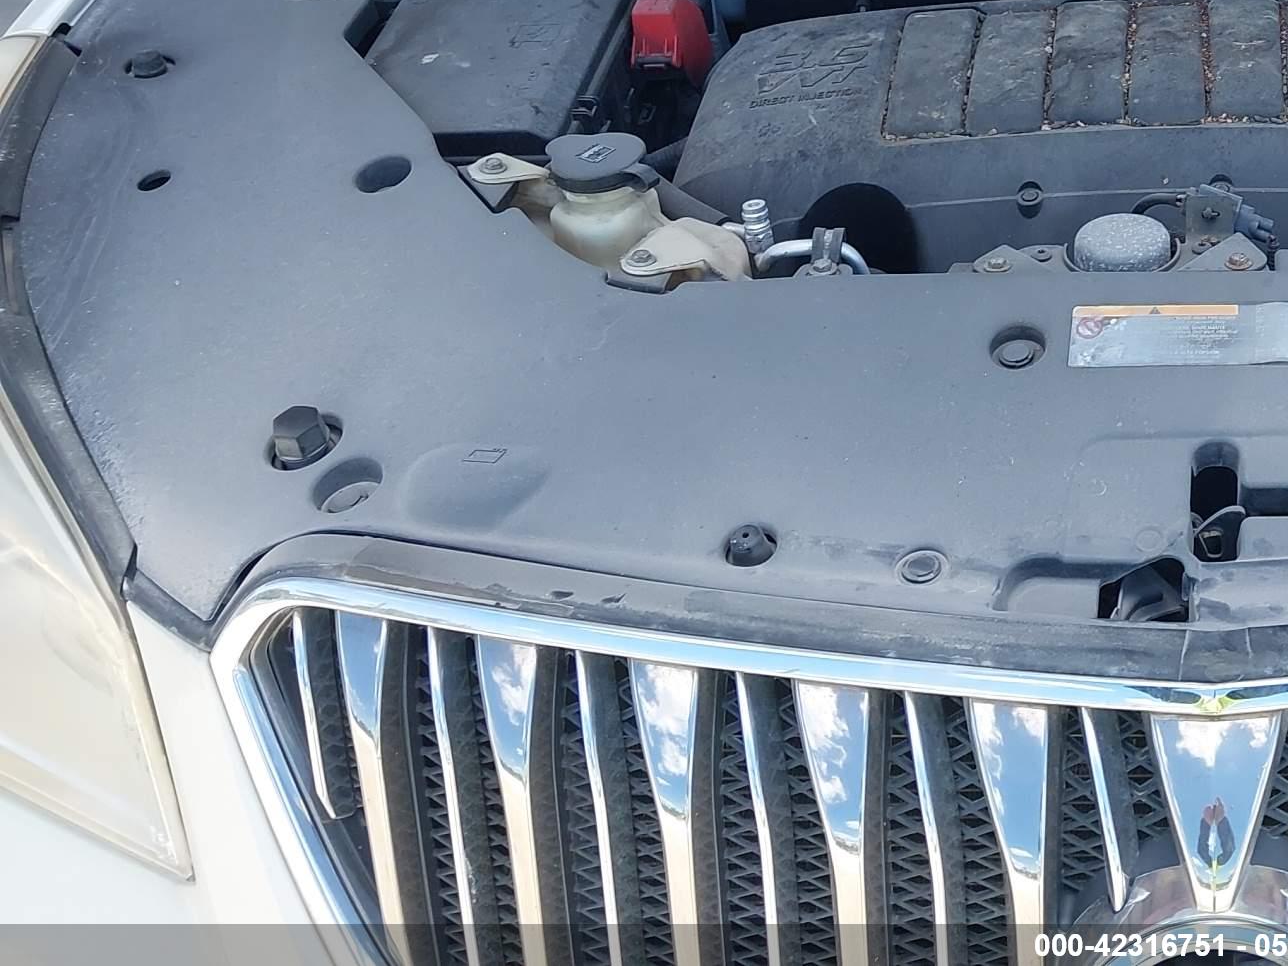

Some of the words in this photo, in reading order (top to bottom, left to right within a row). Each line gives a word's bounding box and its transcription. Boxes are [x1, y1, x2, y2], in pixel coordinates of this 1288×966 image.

[759, 42, 873, 76] 3.6
[749, 95, 795, 109] DIRECT
[798, 87, 863, 103] INJECTION
